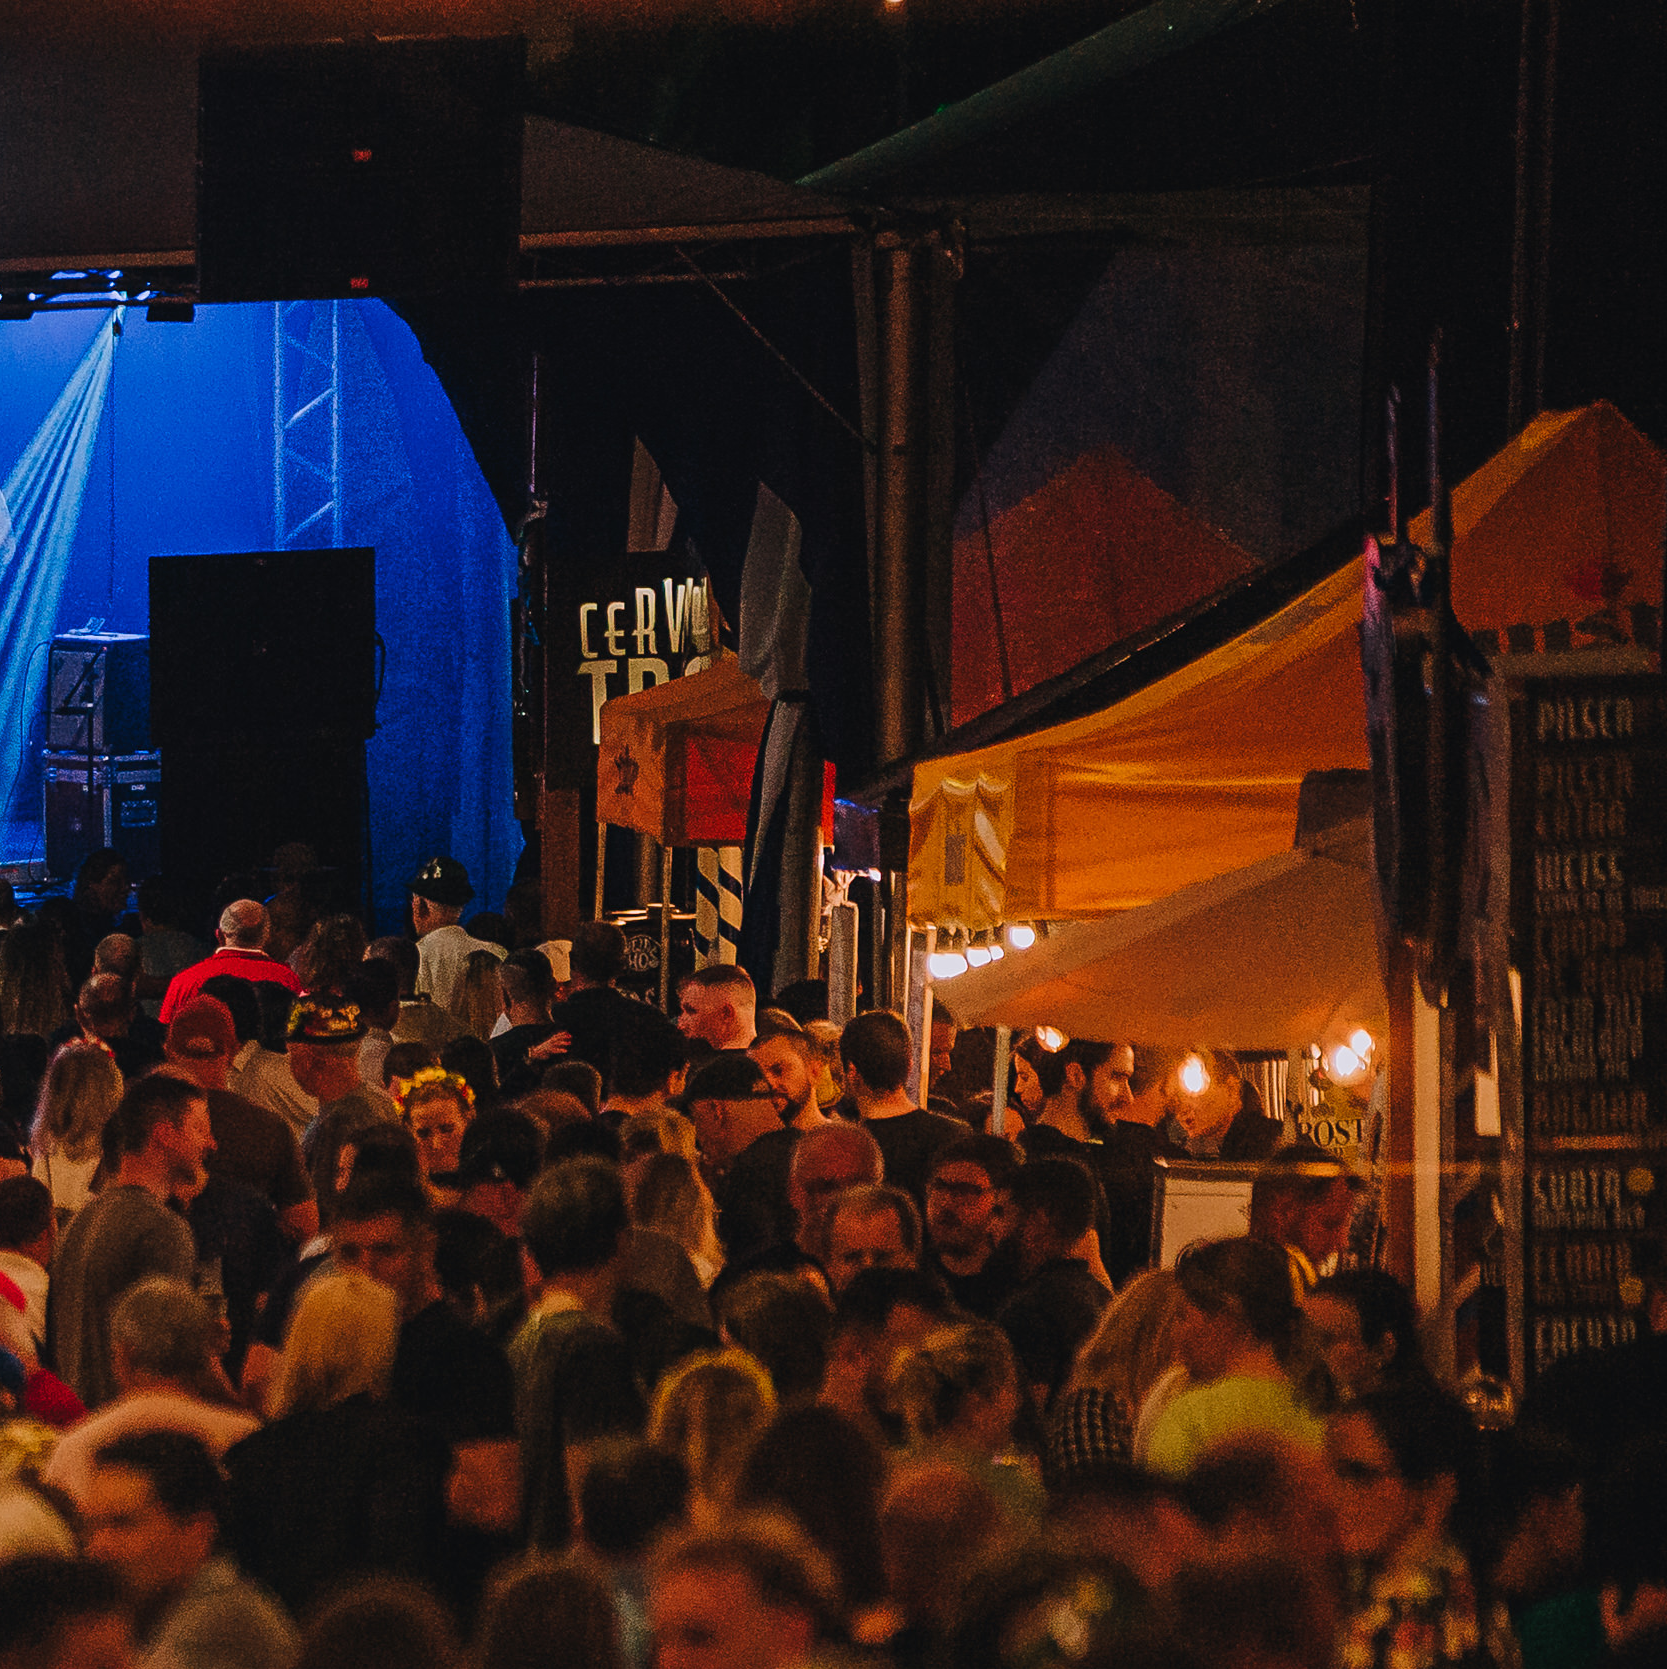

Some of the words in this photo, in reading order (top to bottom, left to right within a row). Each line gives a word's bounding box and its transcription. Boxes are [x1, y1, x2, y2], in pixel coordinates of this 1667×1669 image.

[579, 576, 709, 659] CERV
[1536, 696, 1633, 742] PILSEN
[1535, 849, 1624, 890] WEISS
